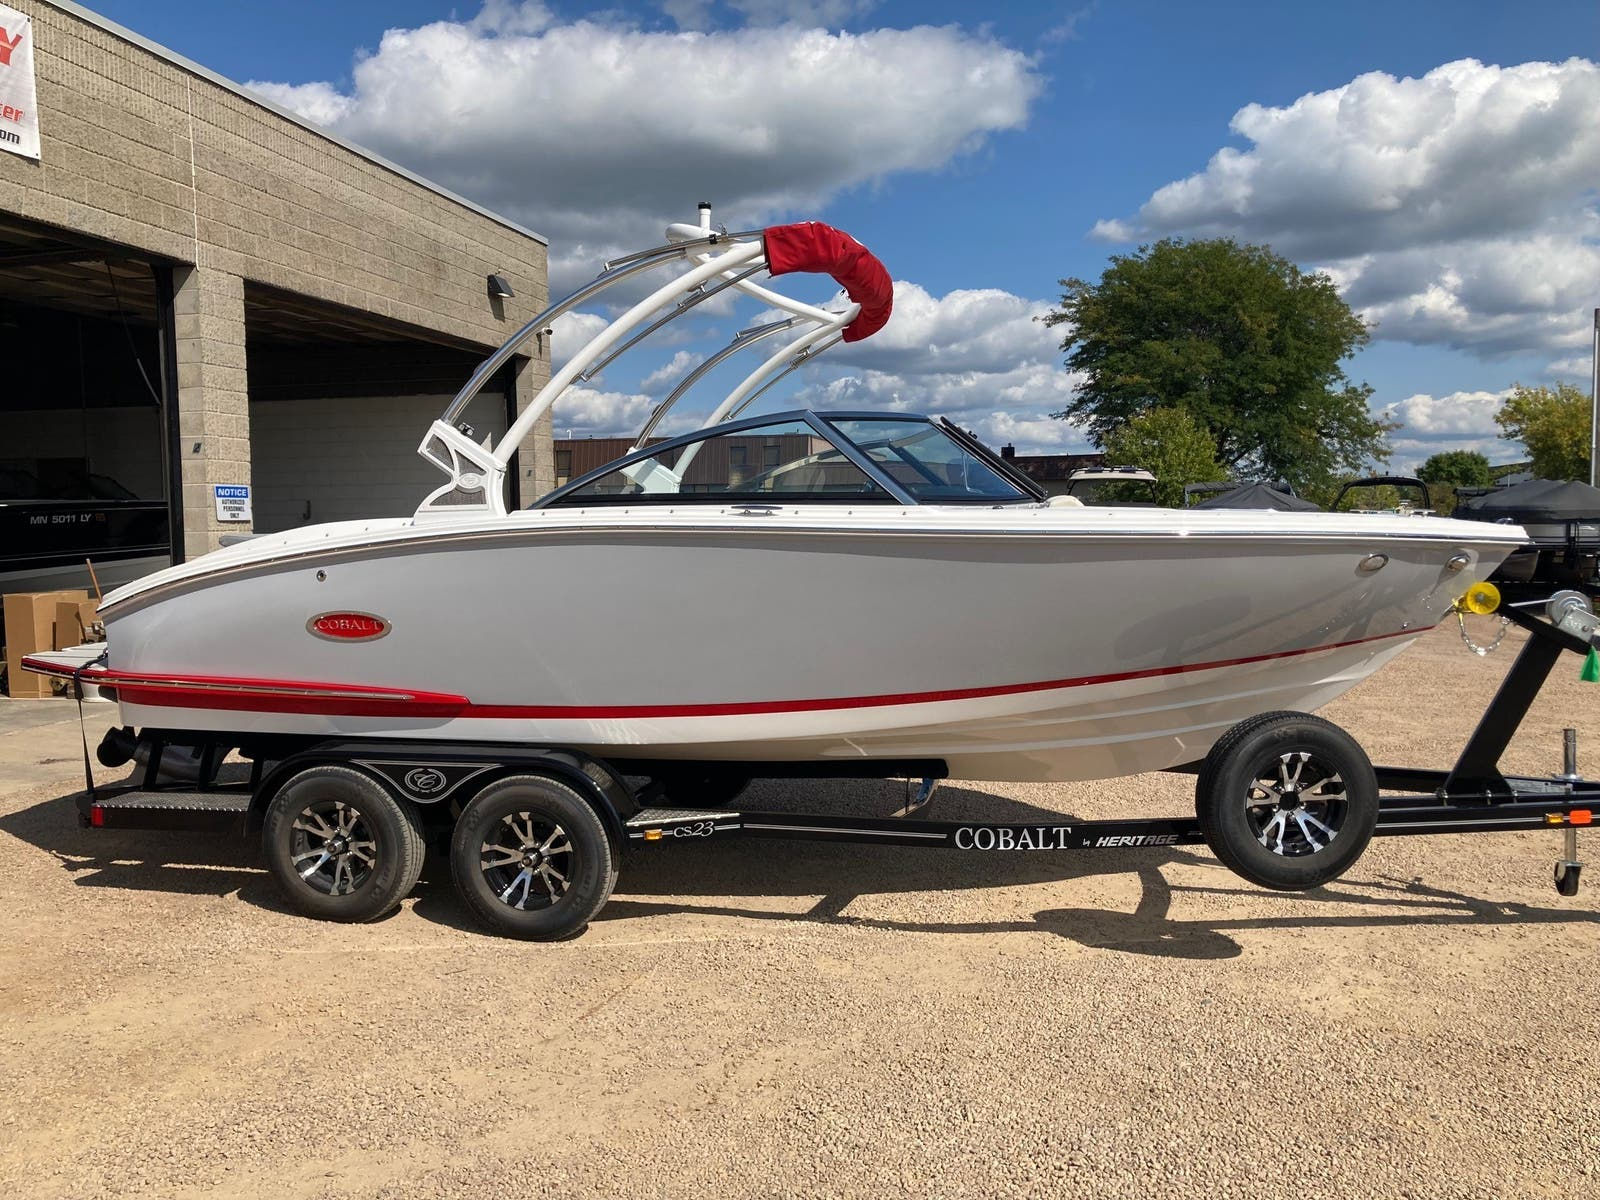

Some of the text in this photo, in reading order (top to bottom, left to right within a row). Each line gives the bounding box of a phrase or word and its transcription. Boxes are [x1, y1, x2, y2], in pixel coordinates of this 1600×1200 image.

[217, 488, 247, 497] NOTICE
[30, 516, 48, 525] MN
[52, 514, 76, 524] 5011
[80, 513, 92, 522] LY
[317, 619, 380, 631] COBALT
[954, 827, 1072, 850] COBALT
[1095, 834, 1180, 847] HERITAGE
